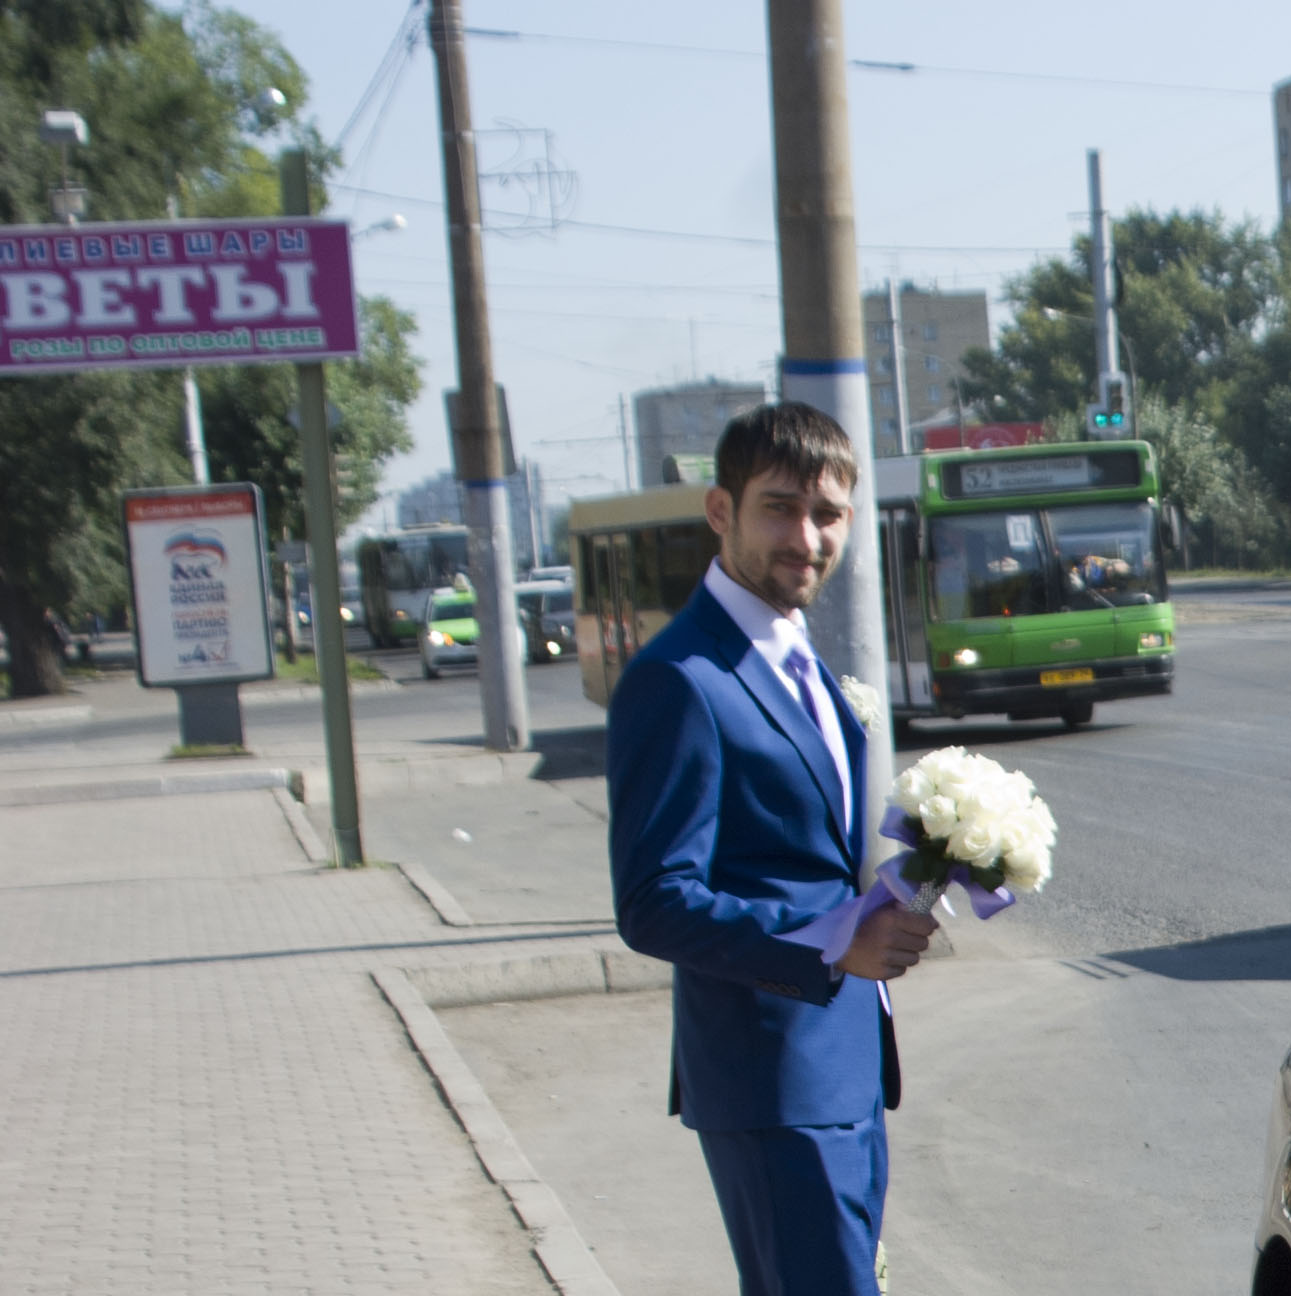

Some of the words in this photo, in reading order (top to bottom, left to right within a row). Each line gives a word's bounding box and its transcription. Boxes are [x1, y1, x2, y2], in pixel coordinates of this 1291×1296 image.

[184, 229, 307, 256] ШАРЫ
[11, 338, 83, 357] РОЗЫ
[89, 336, 126, 354] ПО
[131, 328, 249, 353] ОПТОВОЙ
[256, 328, 324, 347] ЦЕНЕ
[965, 467, 992, 490] 52
